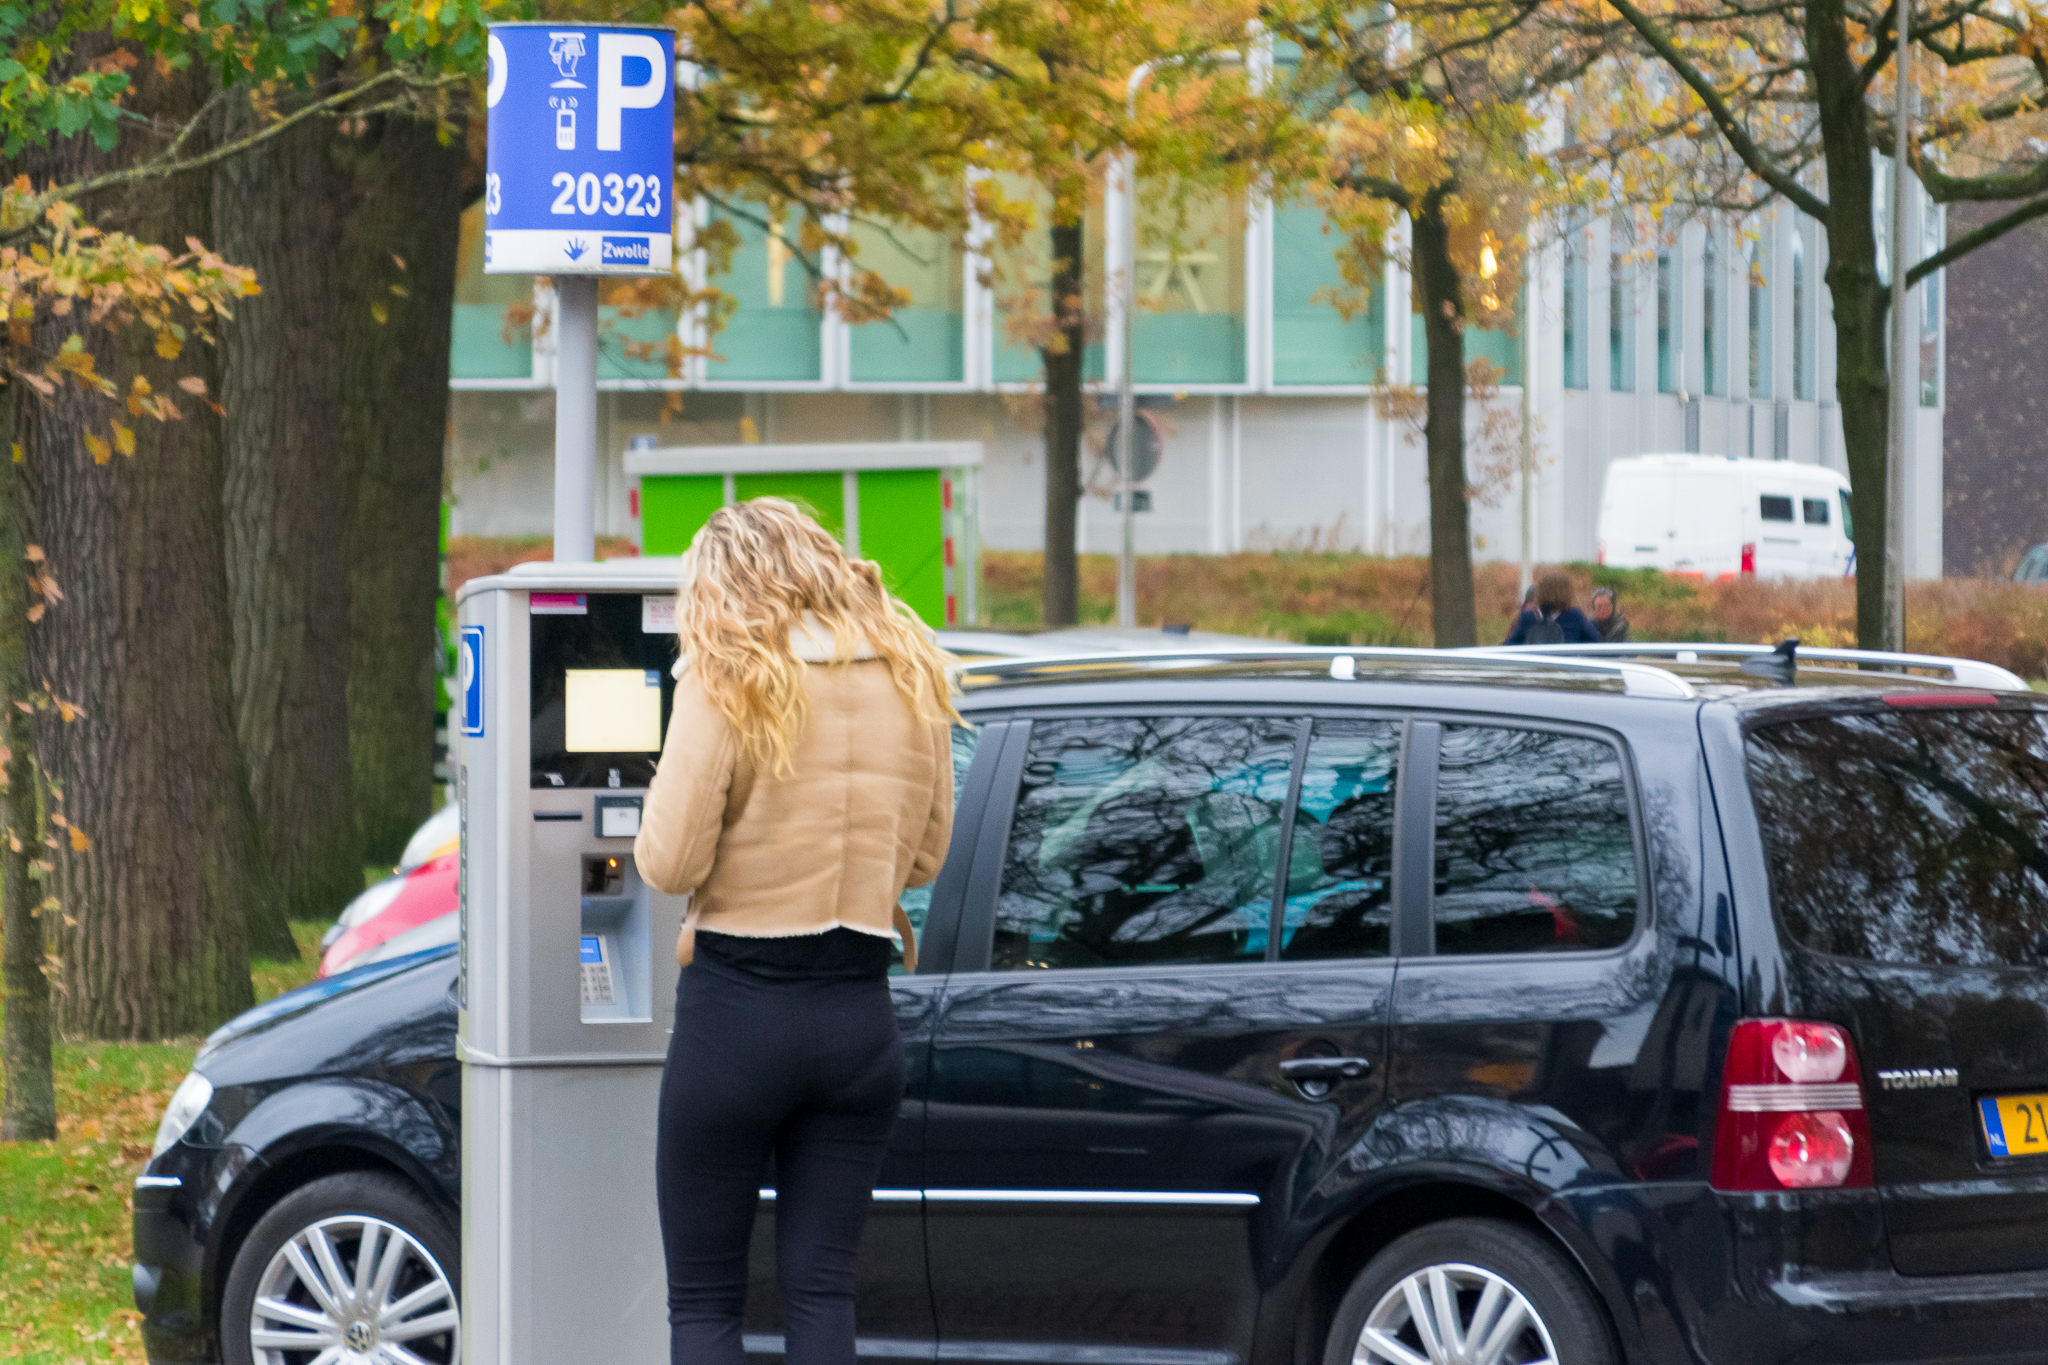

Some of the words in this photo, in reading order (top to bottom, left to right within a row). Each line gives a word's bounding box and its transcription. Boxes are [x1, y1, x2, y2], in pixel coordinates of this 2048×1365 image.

[597, 32, 666, 151] P
[551, 171, 661, 217] 20323
[603, 241, 650, 260] Zwolle
[1877, 1067, 1959, 1090] TOURAN
[1988, 1132, 2005, 1147] NL
